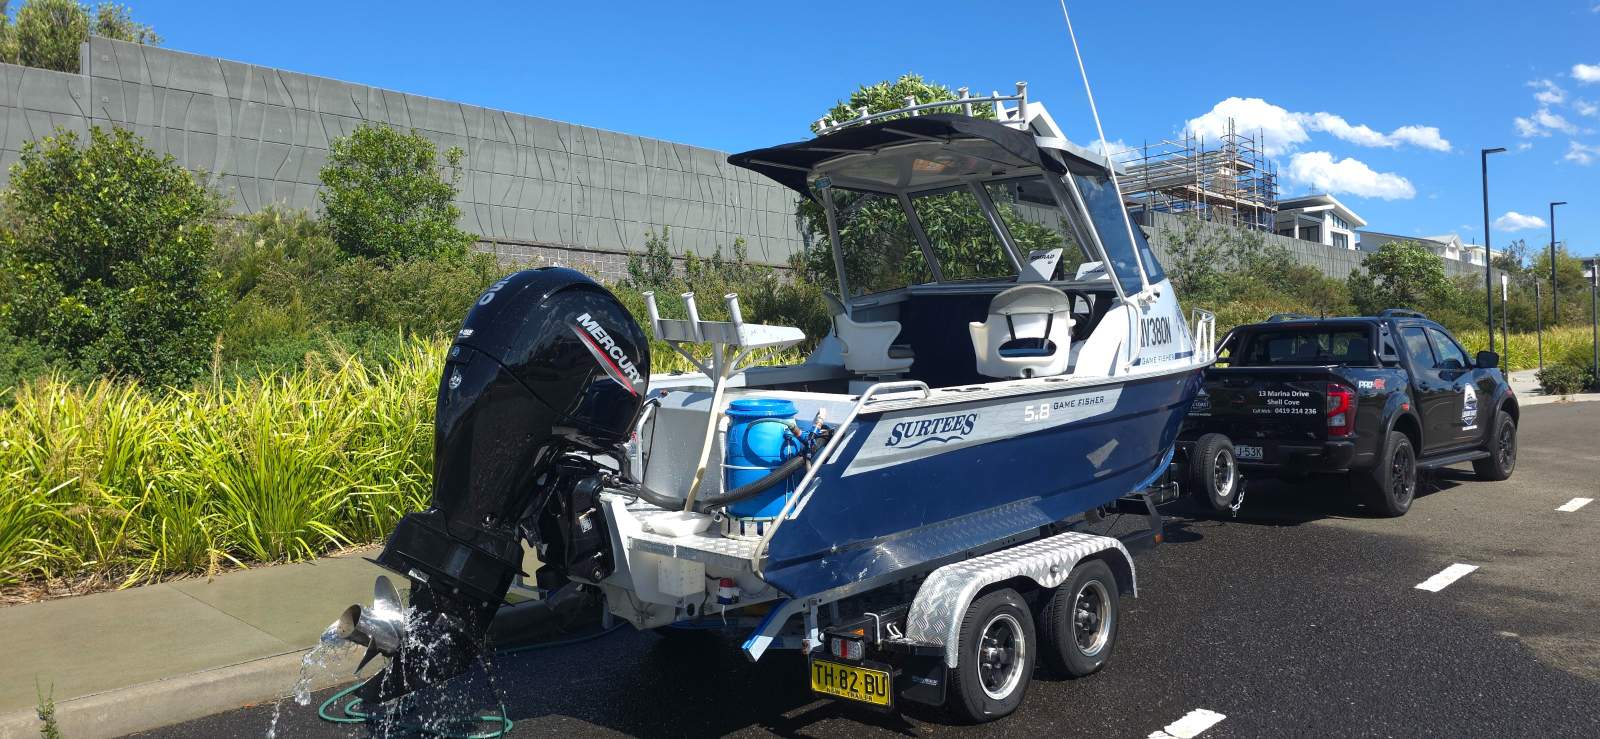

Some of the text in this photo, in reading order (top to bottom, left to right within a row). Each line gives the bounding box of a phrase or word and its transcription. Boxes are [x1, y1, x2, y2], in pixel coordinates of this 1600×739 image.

[576, 312, 644, 386] MERCURY
[1024, 395, 1105, 423] 5.8 GAME FISHER
[885, 412, 978, 447] SURTEES
